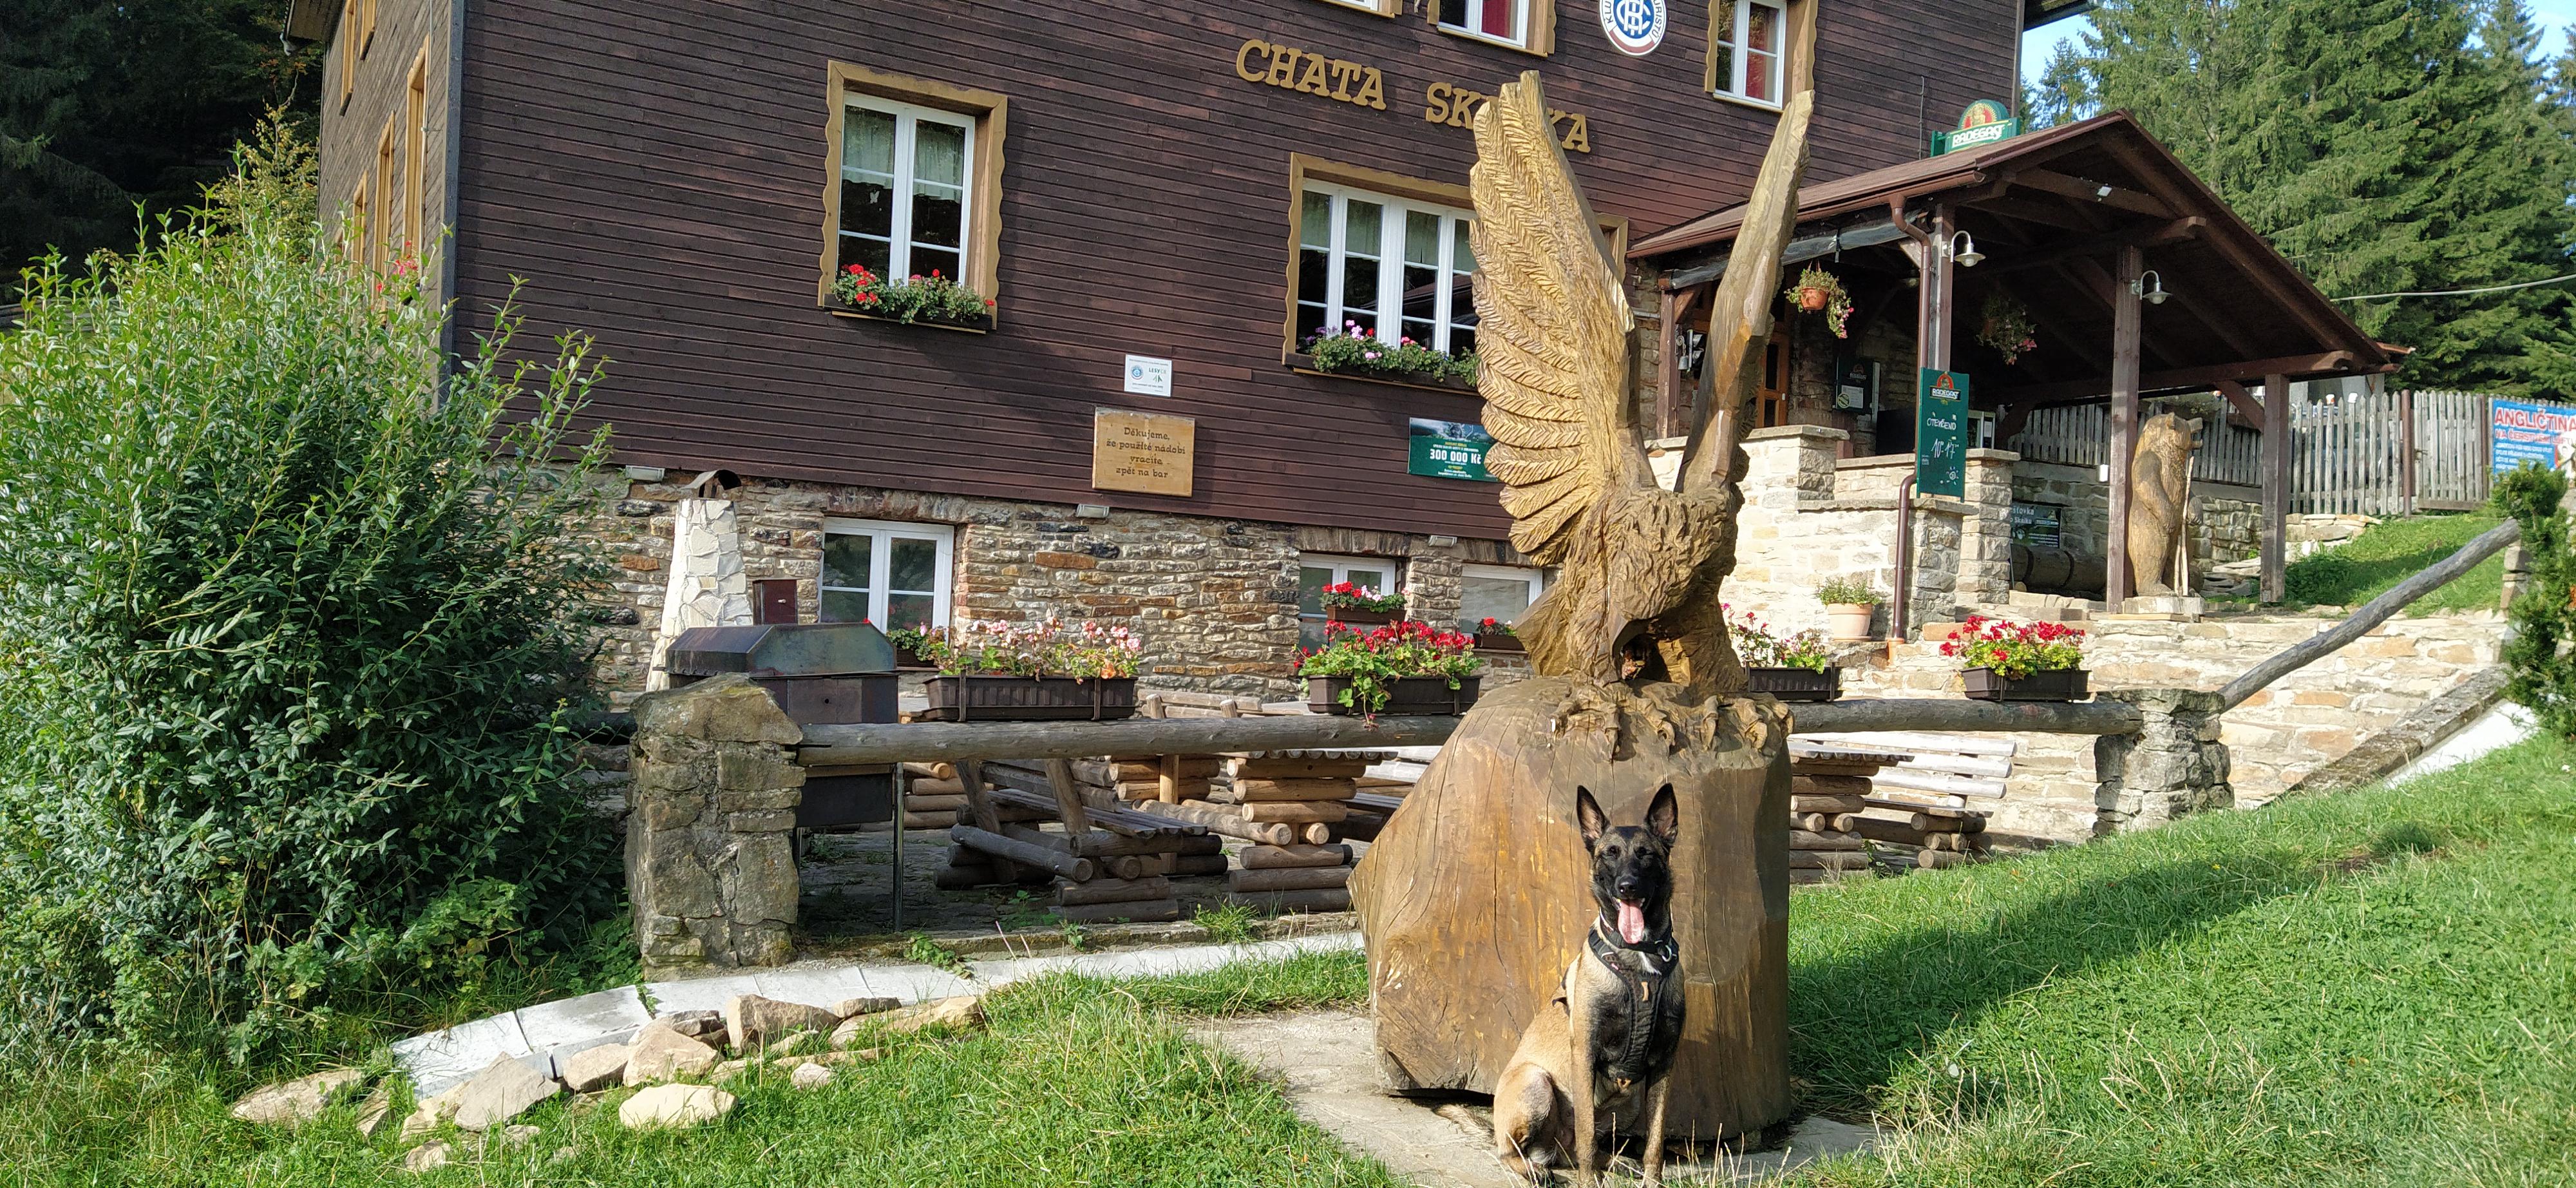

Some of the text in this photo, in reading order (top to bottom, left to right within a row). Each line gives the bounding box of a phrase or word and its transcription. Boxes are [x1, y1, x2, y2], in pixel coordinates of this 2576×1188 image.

[1236, 39, 1387, 110] CHATA
[1952, 124, 2005, 148] RADEGAST
[1932, 388, 1960, 400] RADEGAST
[1927, 417, 1956, 430] OTEVŘENO
[2494, 407, 2576, 432] ANGLIČTINA
[1124, 427, 1170, 441] Děkujeme,
[1106, 439, 1116, 447] že
[1155, 445, 1186, 455] nádobí
[1430, 448, 1448, 461] 300
[1450, 451, 1468, 463] 000
[1471, 453, 1481, 465] Kč
[1116, 466, 1135, 477] zpět
[1153, 469, 1168, 478] bar
